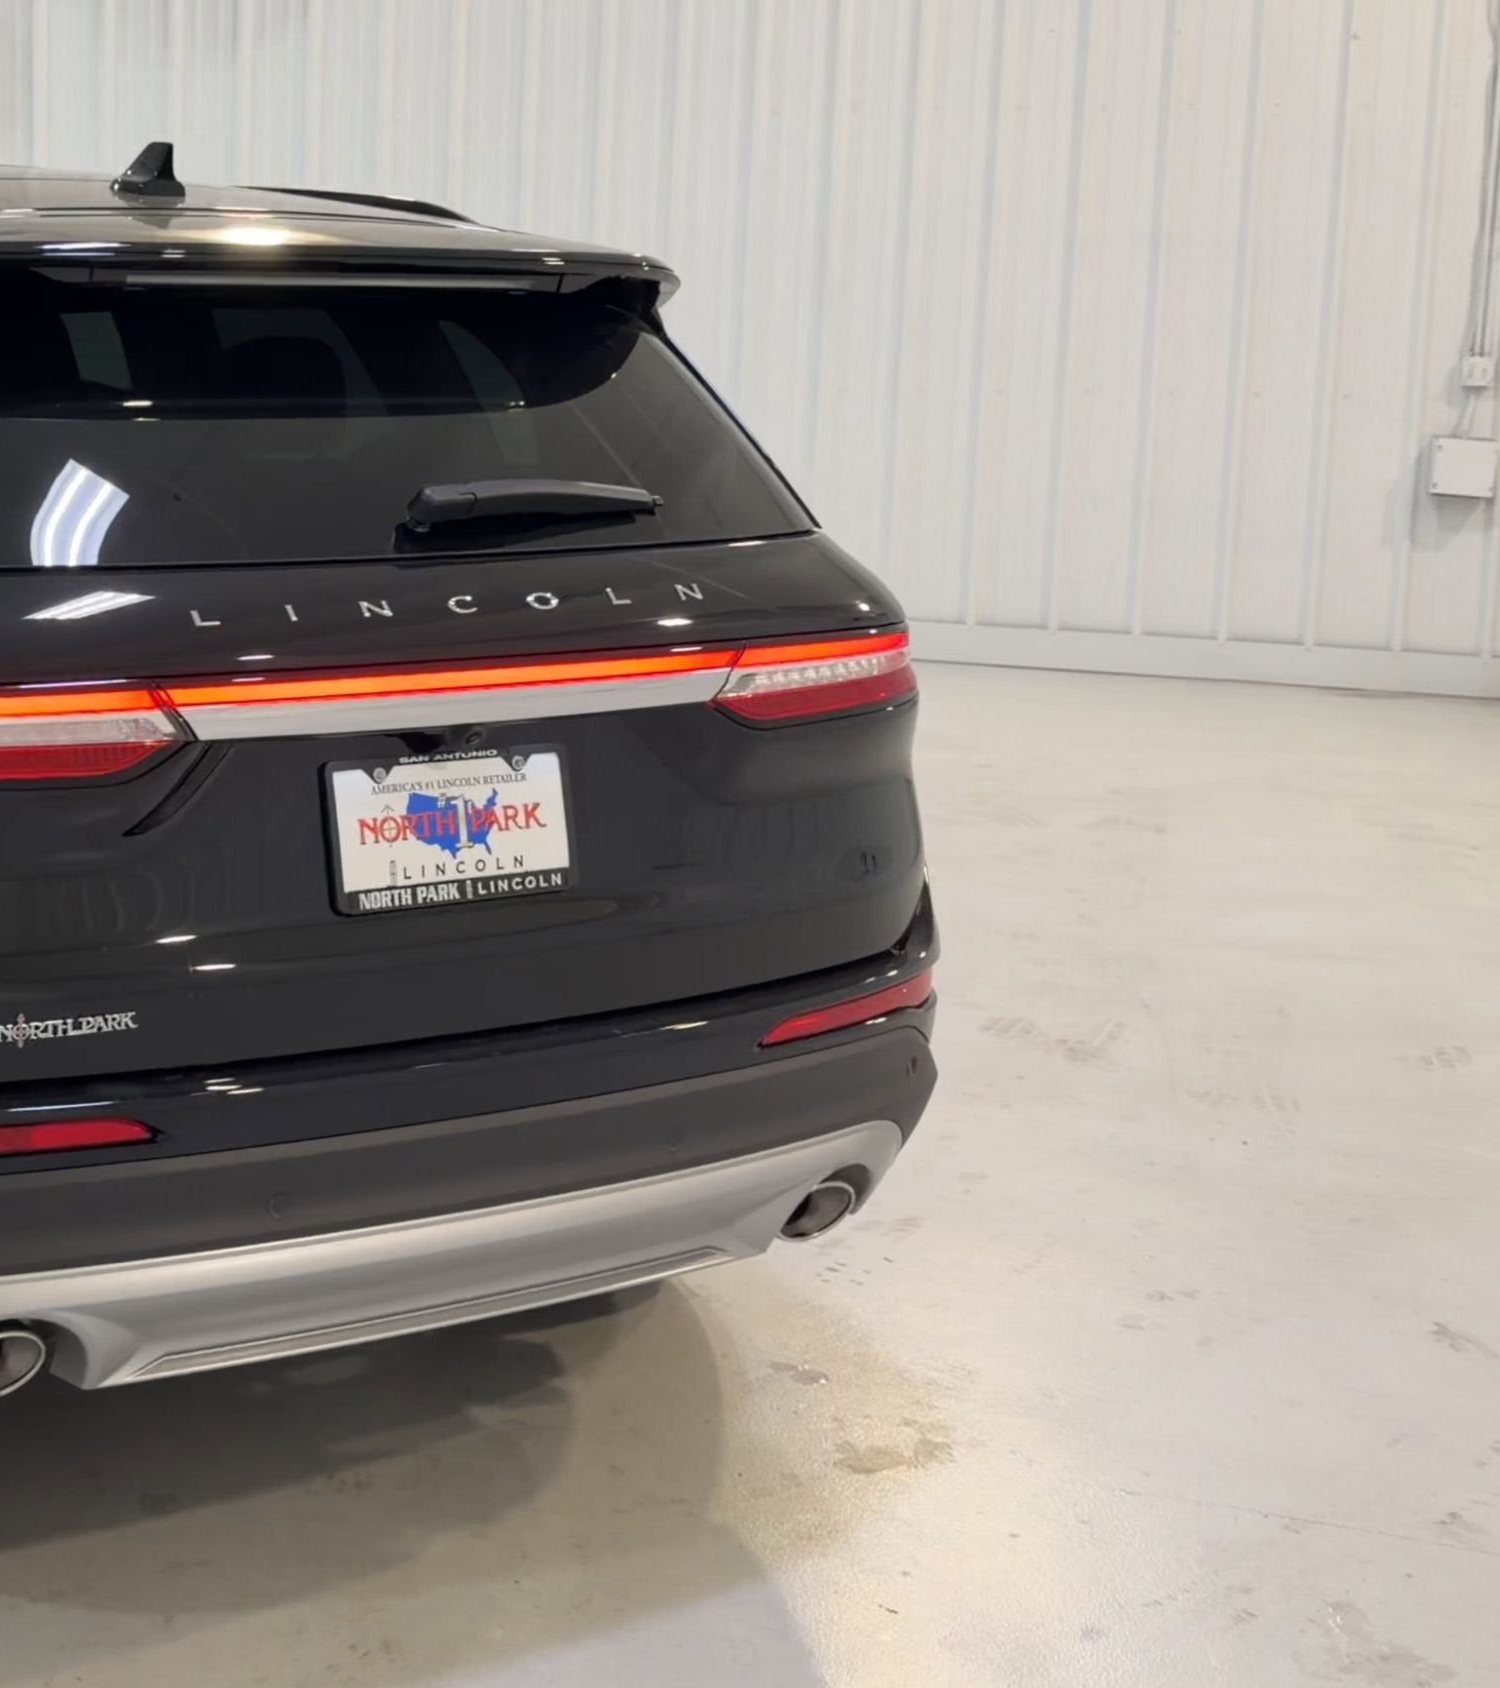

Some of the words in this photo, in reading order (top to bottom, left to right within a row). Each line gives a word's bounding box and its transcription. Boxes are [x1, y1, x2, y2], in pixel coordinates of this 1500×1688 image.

[190, 583, 703, 626] LINCOLN
[398, 756, 430, 764] SAN
[433, 749, 499, 761] ANTONIO
[371, 781, 424, 796] AMERICA'S
[437, 775, 481, 790] LINCOLN
[482, 772, 528, 784] RETAILER
[357, 812, 457, 845] NORTH
[469, 801, 547, 832] PARK
[402, 854, 525, 880] LINCOLN
[358, 887, 413, 911] NORTH
[415, 882, 461, 904] PARK
[477, 872, 563, 895] LINCOLN
[77, 1011, 139, 1034] PARK
